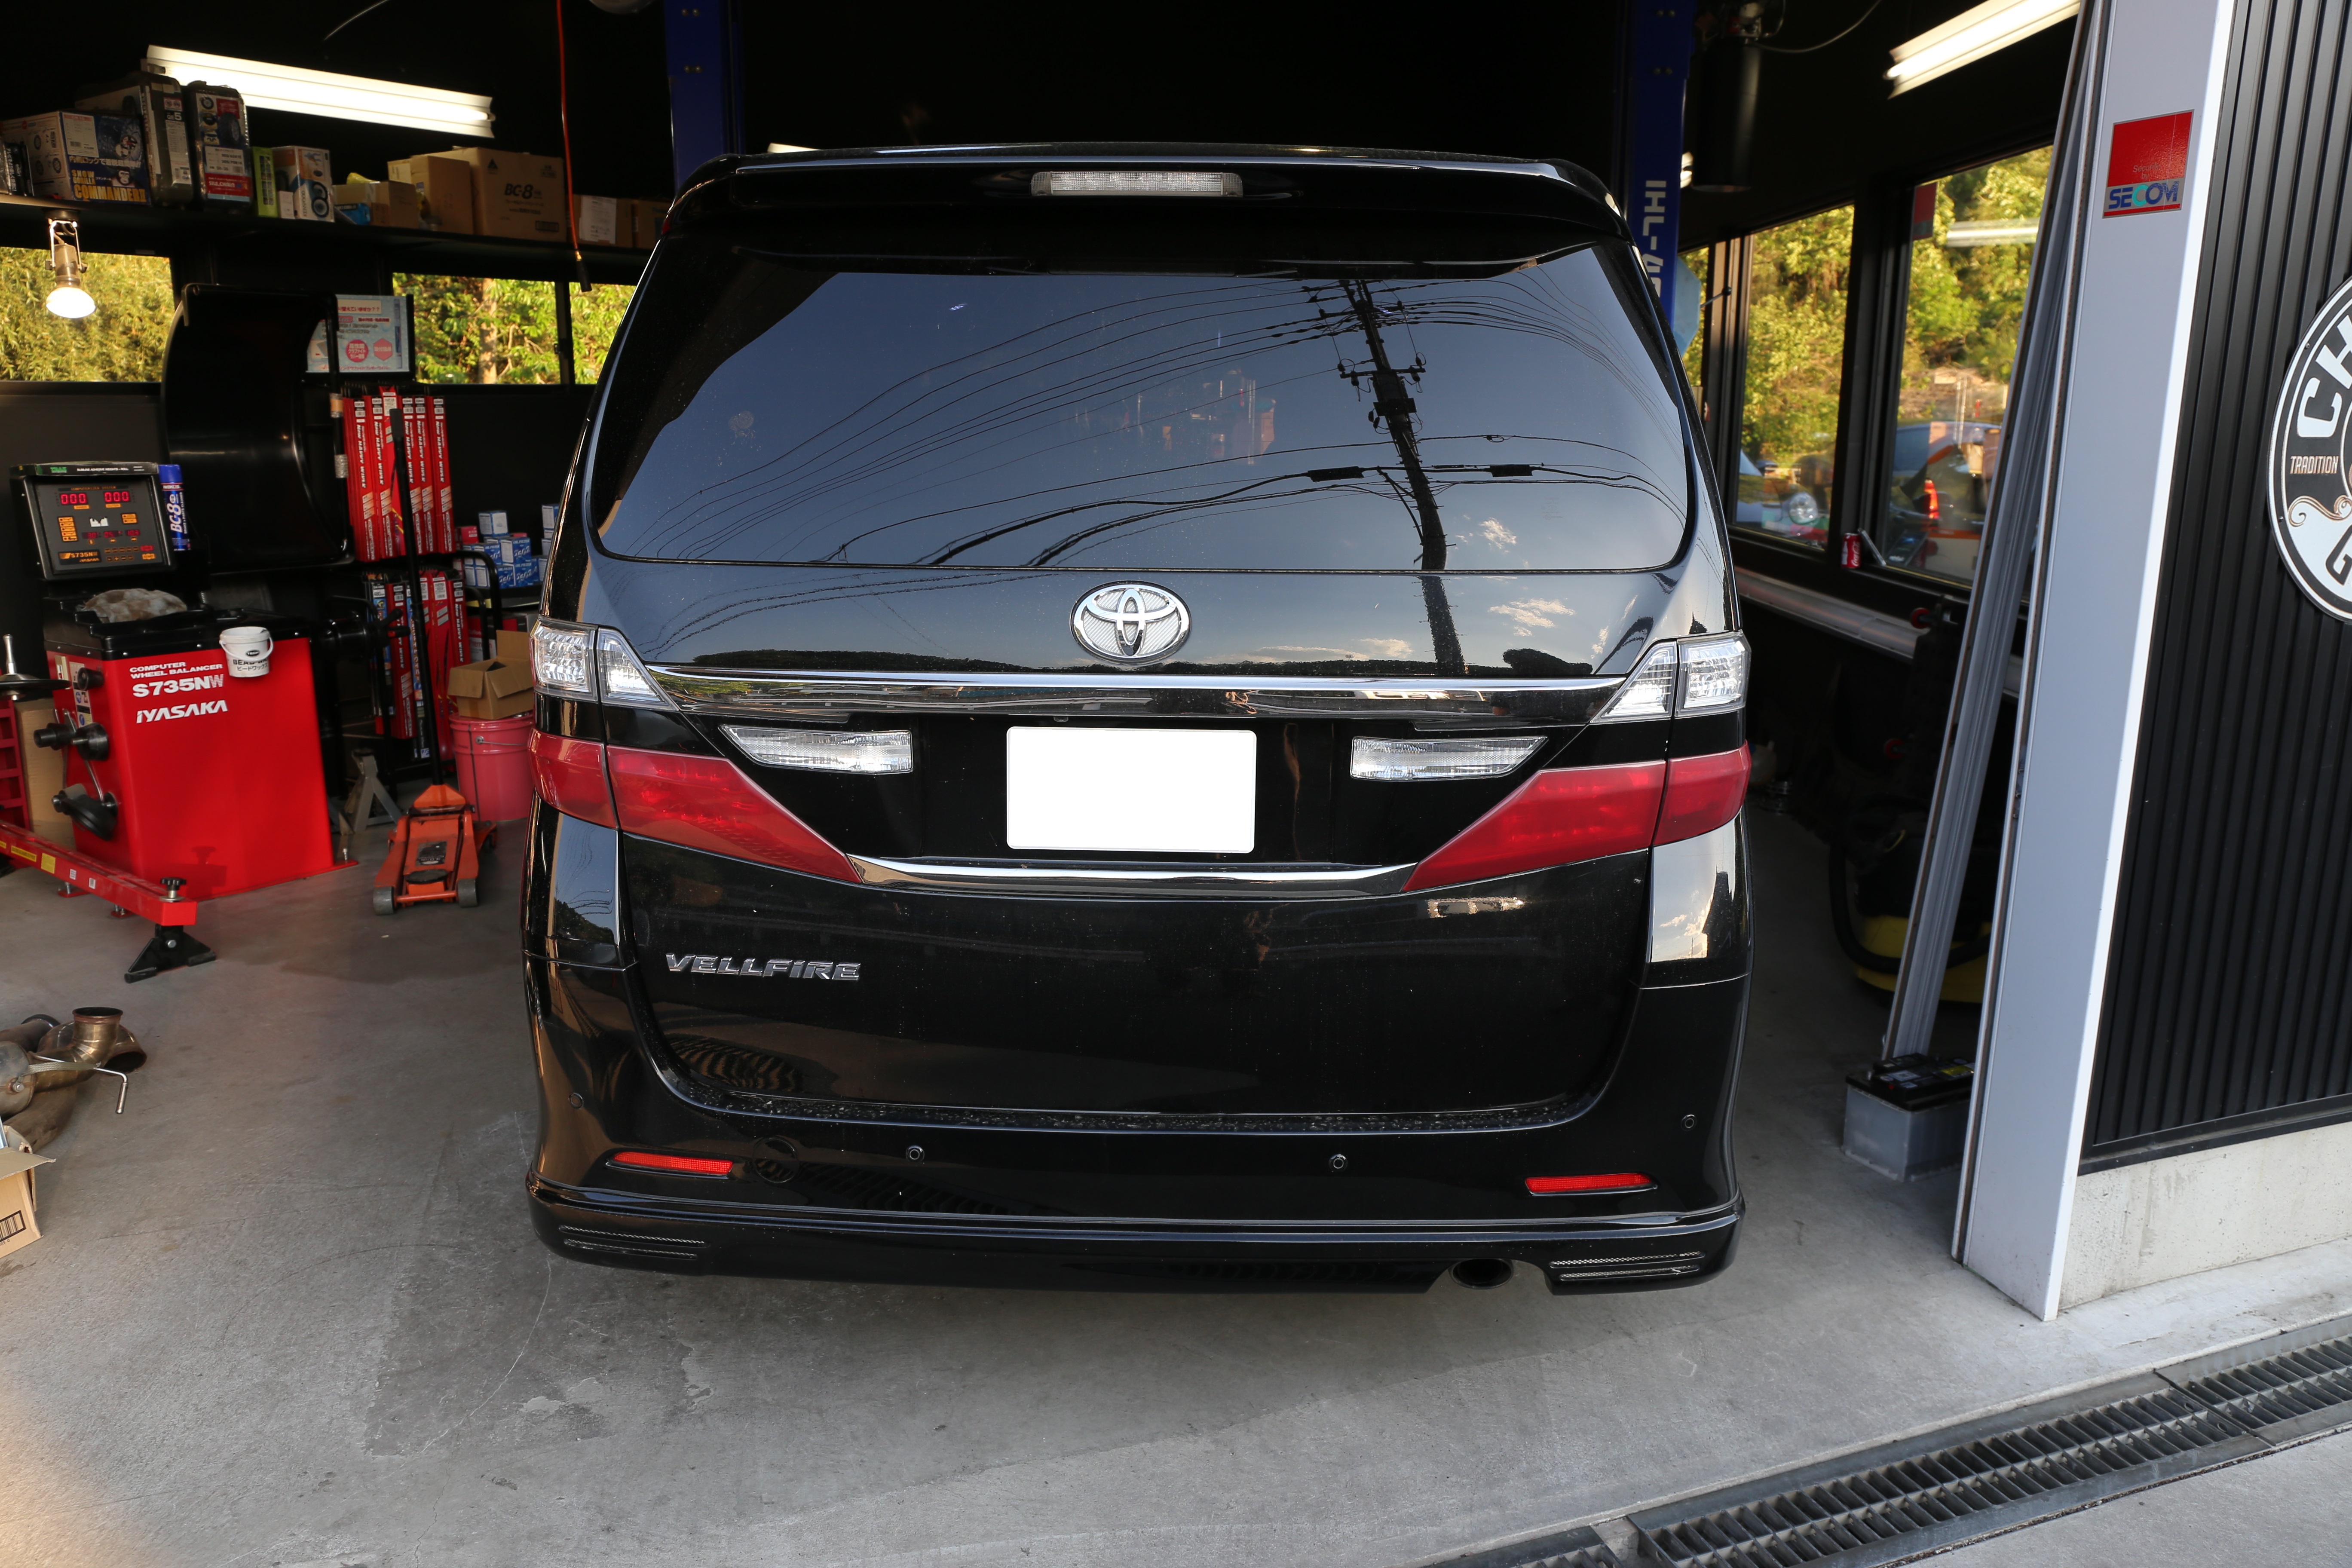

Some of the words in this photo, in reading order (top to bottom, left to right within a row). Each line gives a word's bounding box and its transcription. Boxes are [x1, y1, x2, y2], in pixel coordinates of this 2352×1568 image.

[505, 184, 533, 199] BC-8
[2108, 181, 2179, 209] SECOM
[2290, 456, 2339, 475] TRADITION
[61, 493, 86, 505] 000
[104, 491, 129, 502] 000
[167, 502, 182, 533] BC-8
[129, 662, 186, 673] COMPUTER
[131, 671, 168, 679] WHEEL
[169, 664, 223, 675] BALANCER
[132, 674, 224, 697] S735NW
[136, 700, 228, 724] IYASAKA
[666, 953, 861, 980] VELLFIRE
